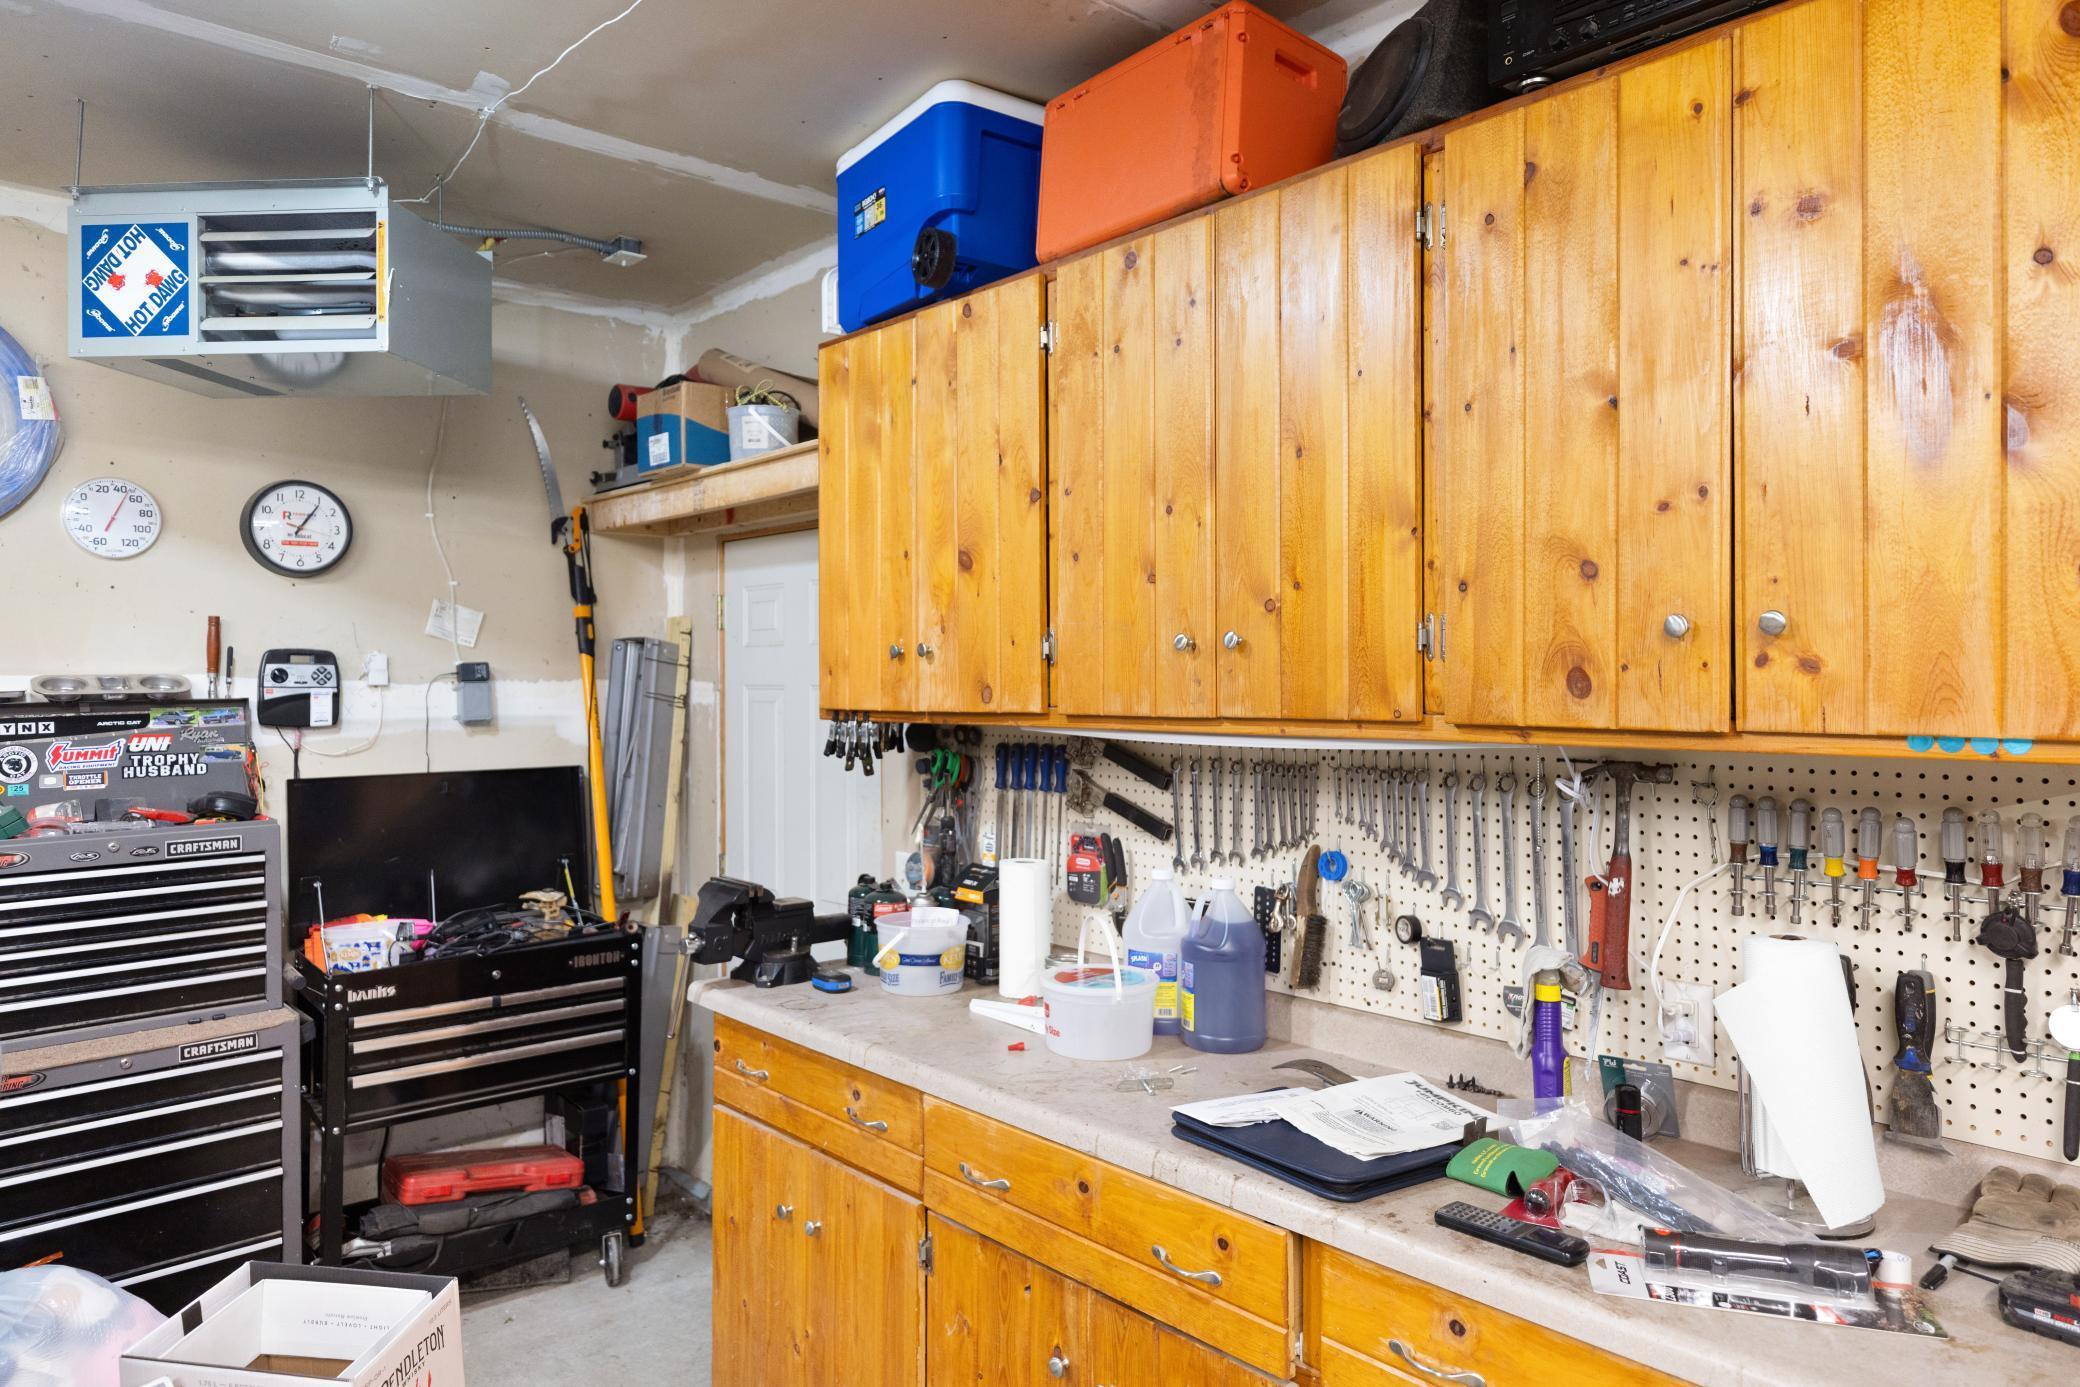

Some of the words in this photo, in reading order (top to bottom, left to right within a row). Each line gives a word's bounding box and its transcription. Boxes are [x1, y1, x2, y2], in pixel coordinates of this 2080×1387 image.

[117, 225, 147, 259] HOT
[84, 252, 122, 291] DAWG
[124, 301, 154, 335] HOT
[148, 269, 187, 309] DAWG
[95, 484, 109, 493] 20
[113, 484, 128, 493] 40
[80, 492, 88, 501] 0
[129, 494, 143, 503] 60
[276, 493, 284, 502] 11
[295, 489, 305, 499] 12
[139, 509, 153, 518] 80
[262, 505, 272, 514] 10
[329, 508, 336, 517] 2
[74, 524, 93, 533] -40
[133, 525, 152, 533] 100
[333, 525, 340, 536] 3
[89, 537, 107, 546] -60
[121, 538, 139, 547] 120
[262, 538, 271, 550] 8
[327, 541, 335, 550] 4
[296, 557, 305, 567] 6
[315, 553, 322, 563] 5
[131, 753, 199, 767] TROPHY
[123, 763, 207, 778] HUSBAND
[169, 839, 238, 854] CRAFTSMAN
[183, 1036, 254, 1058] CRAFTSMAN
